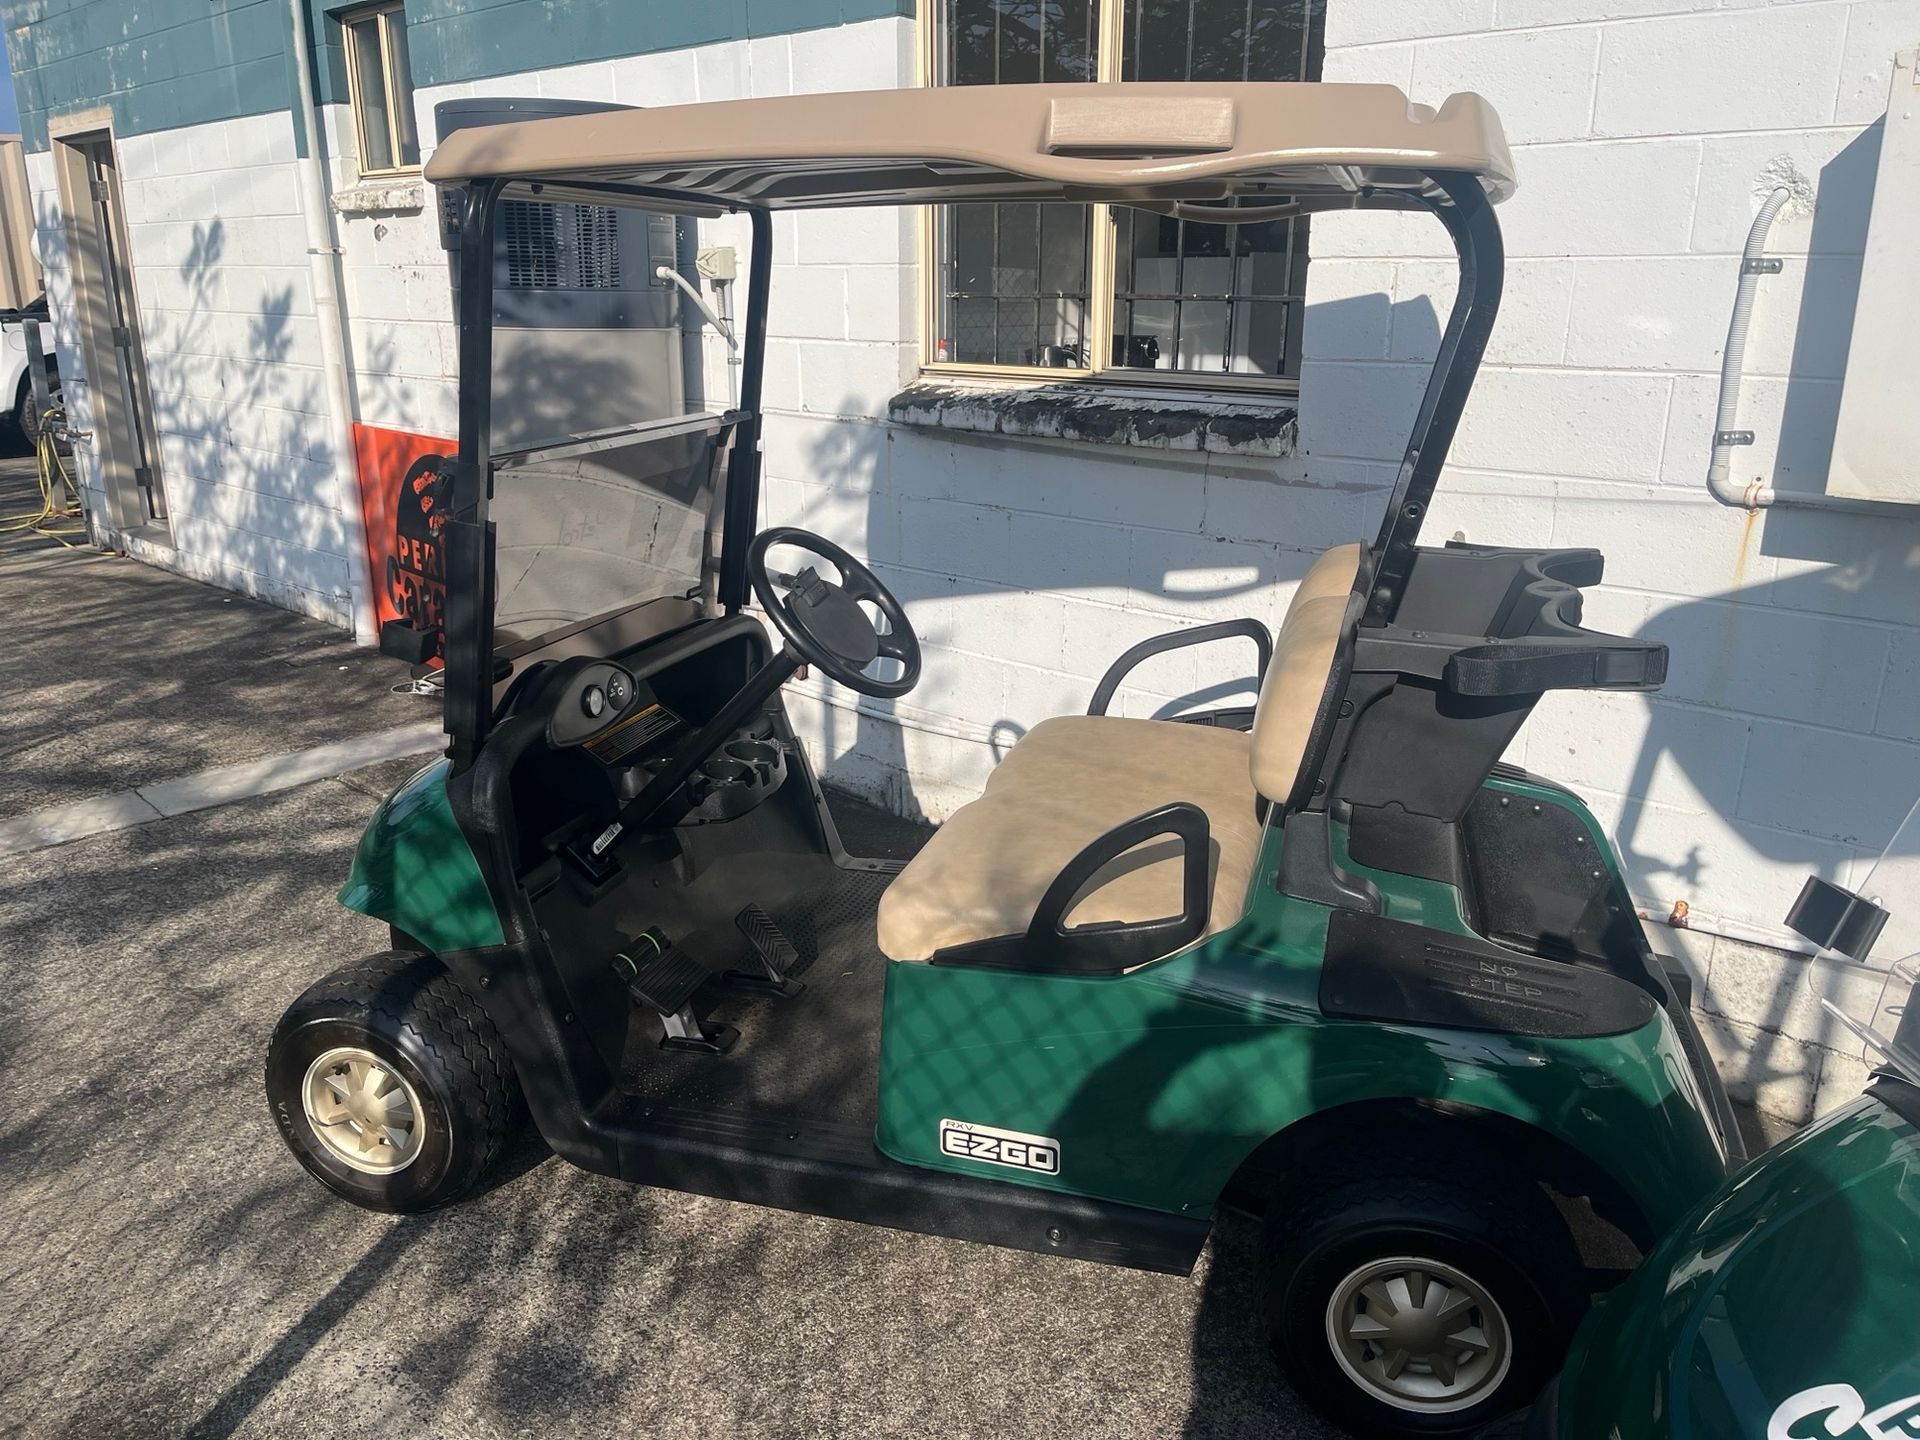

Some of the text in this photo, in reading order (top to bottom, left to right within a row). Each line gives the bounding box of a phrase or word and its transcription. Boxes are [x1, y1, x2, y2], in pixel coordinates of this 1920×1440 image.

[1479, 961, 1518, 977] NO
[1465, 975, 1543, 998] STEP
[945, 1120, 975, 1131] RXV
[944, 1130, 1055, 1170] EZGO
